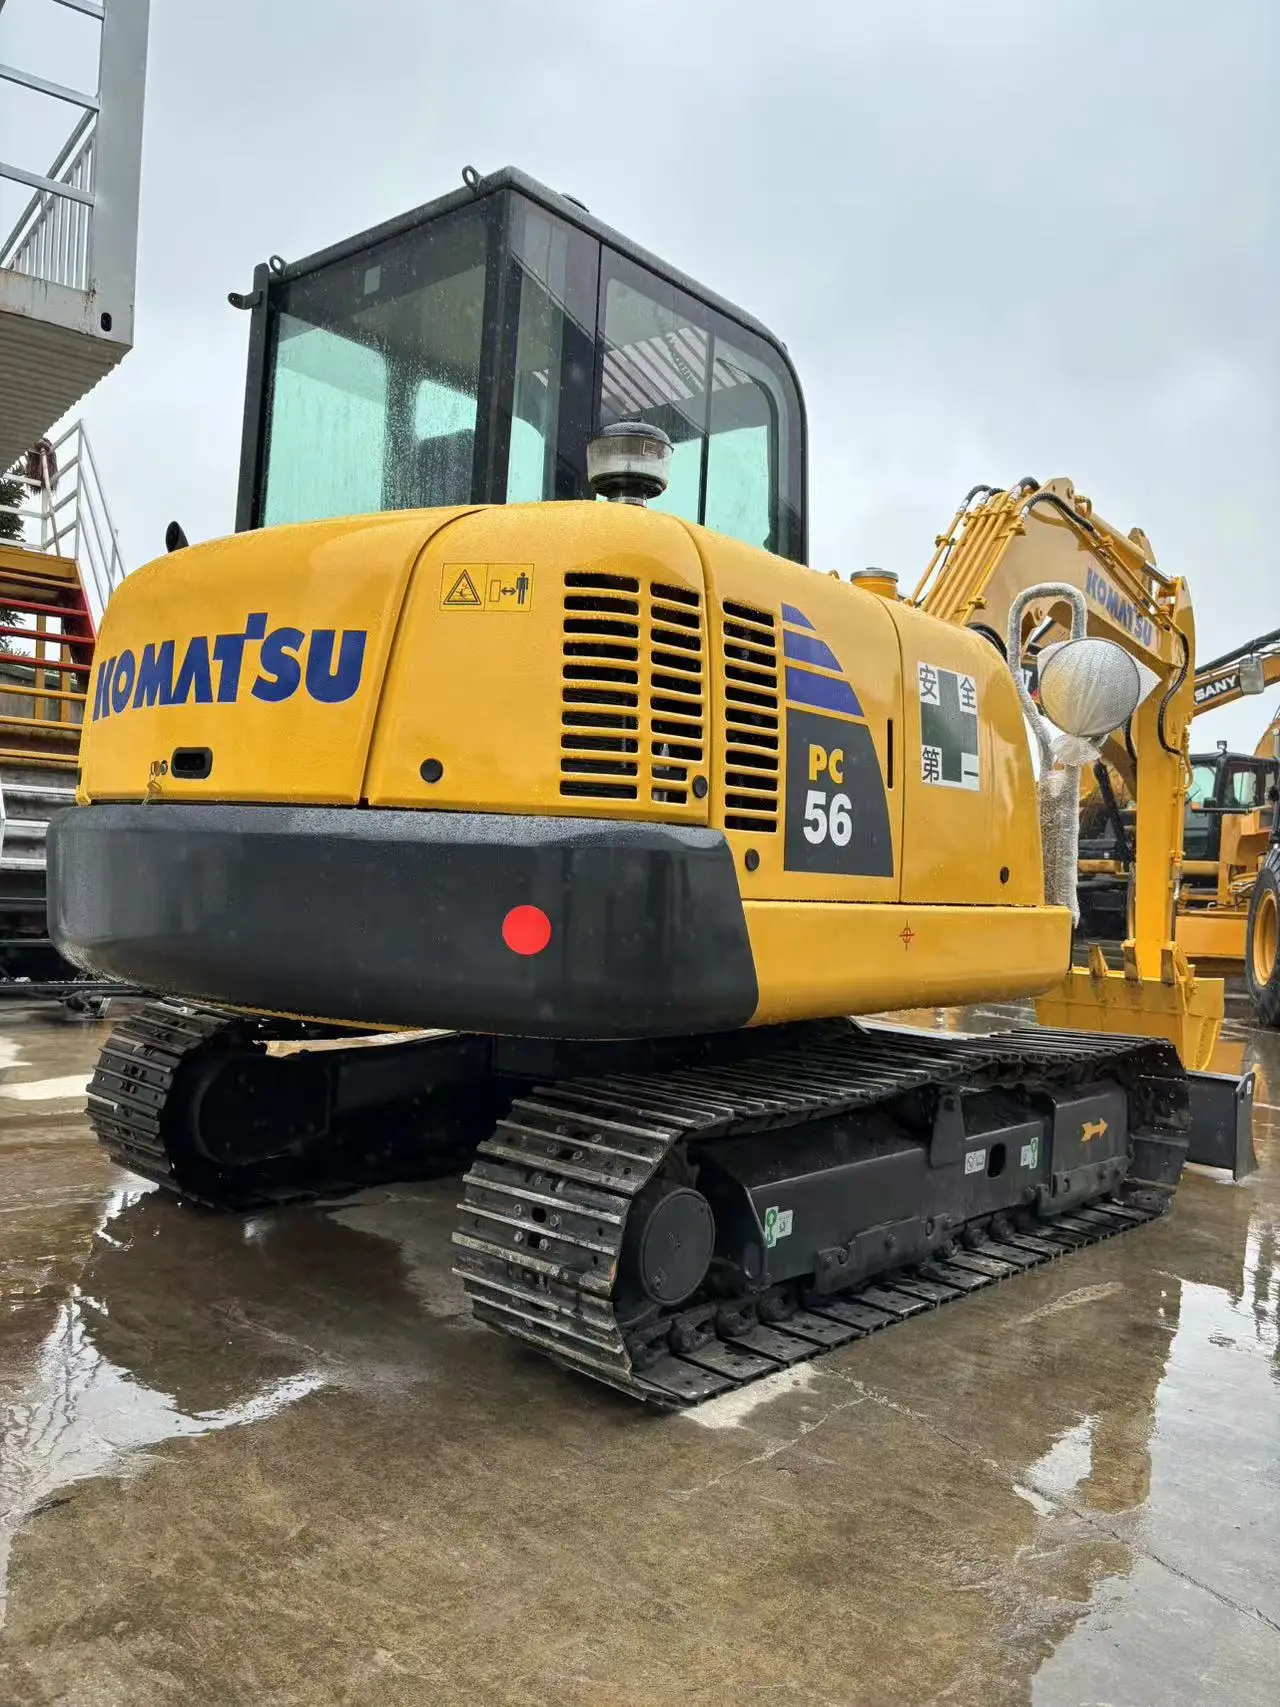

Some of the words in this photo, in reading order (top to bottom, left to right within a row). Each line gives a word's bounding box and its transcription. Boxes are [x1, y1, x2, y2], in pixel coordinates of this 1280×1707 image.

[1086, 567, 1152, 647] KOMATSU
[92, 612, 367, 721] KOMATSU
[919, 664, 976, 710] 安全
[1194, 674, 1236, 702] SANY
[808, 744, 844, 784] PC
[921, 746, 979, 783] 第一
[803, 789, 853, 847] 56
